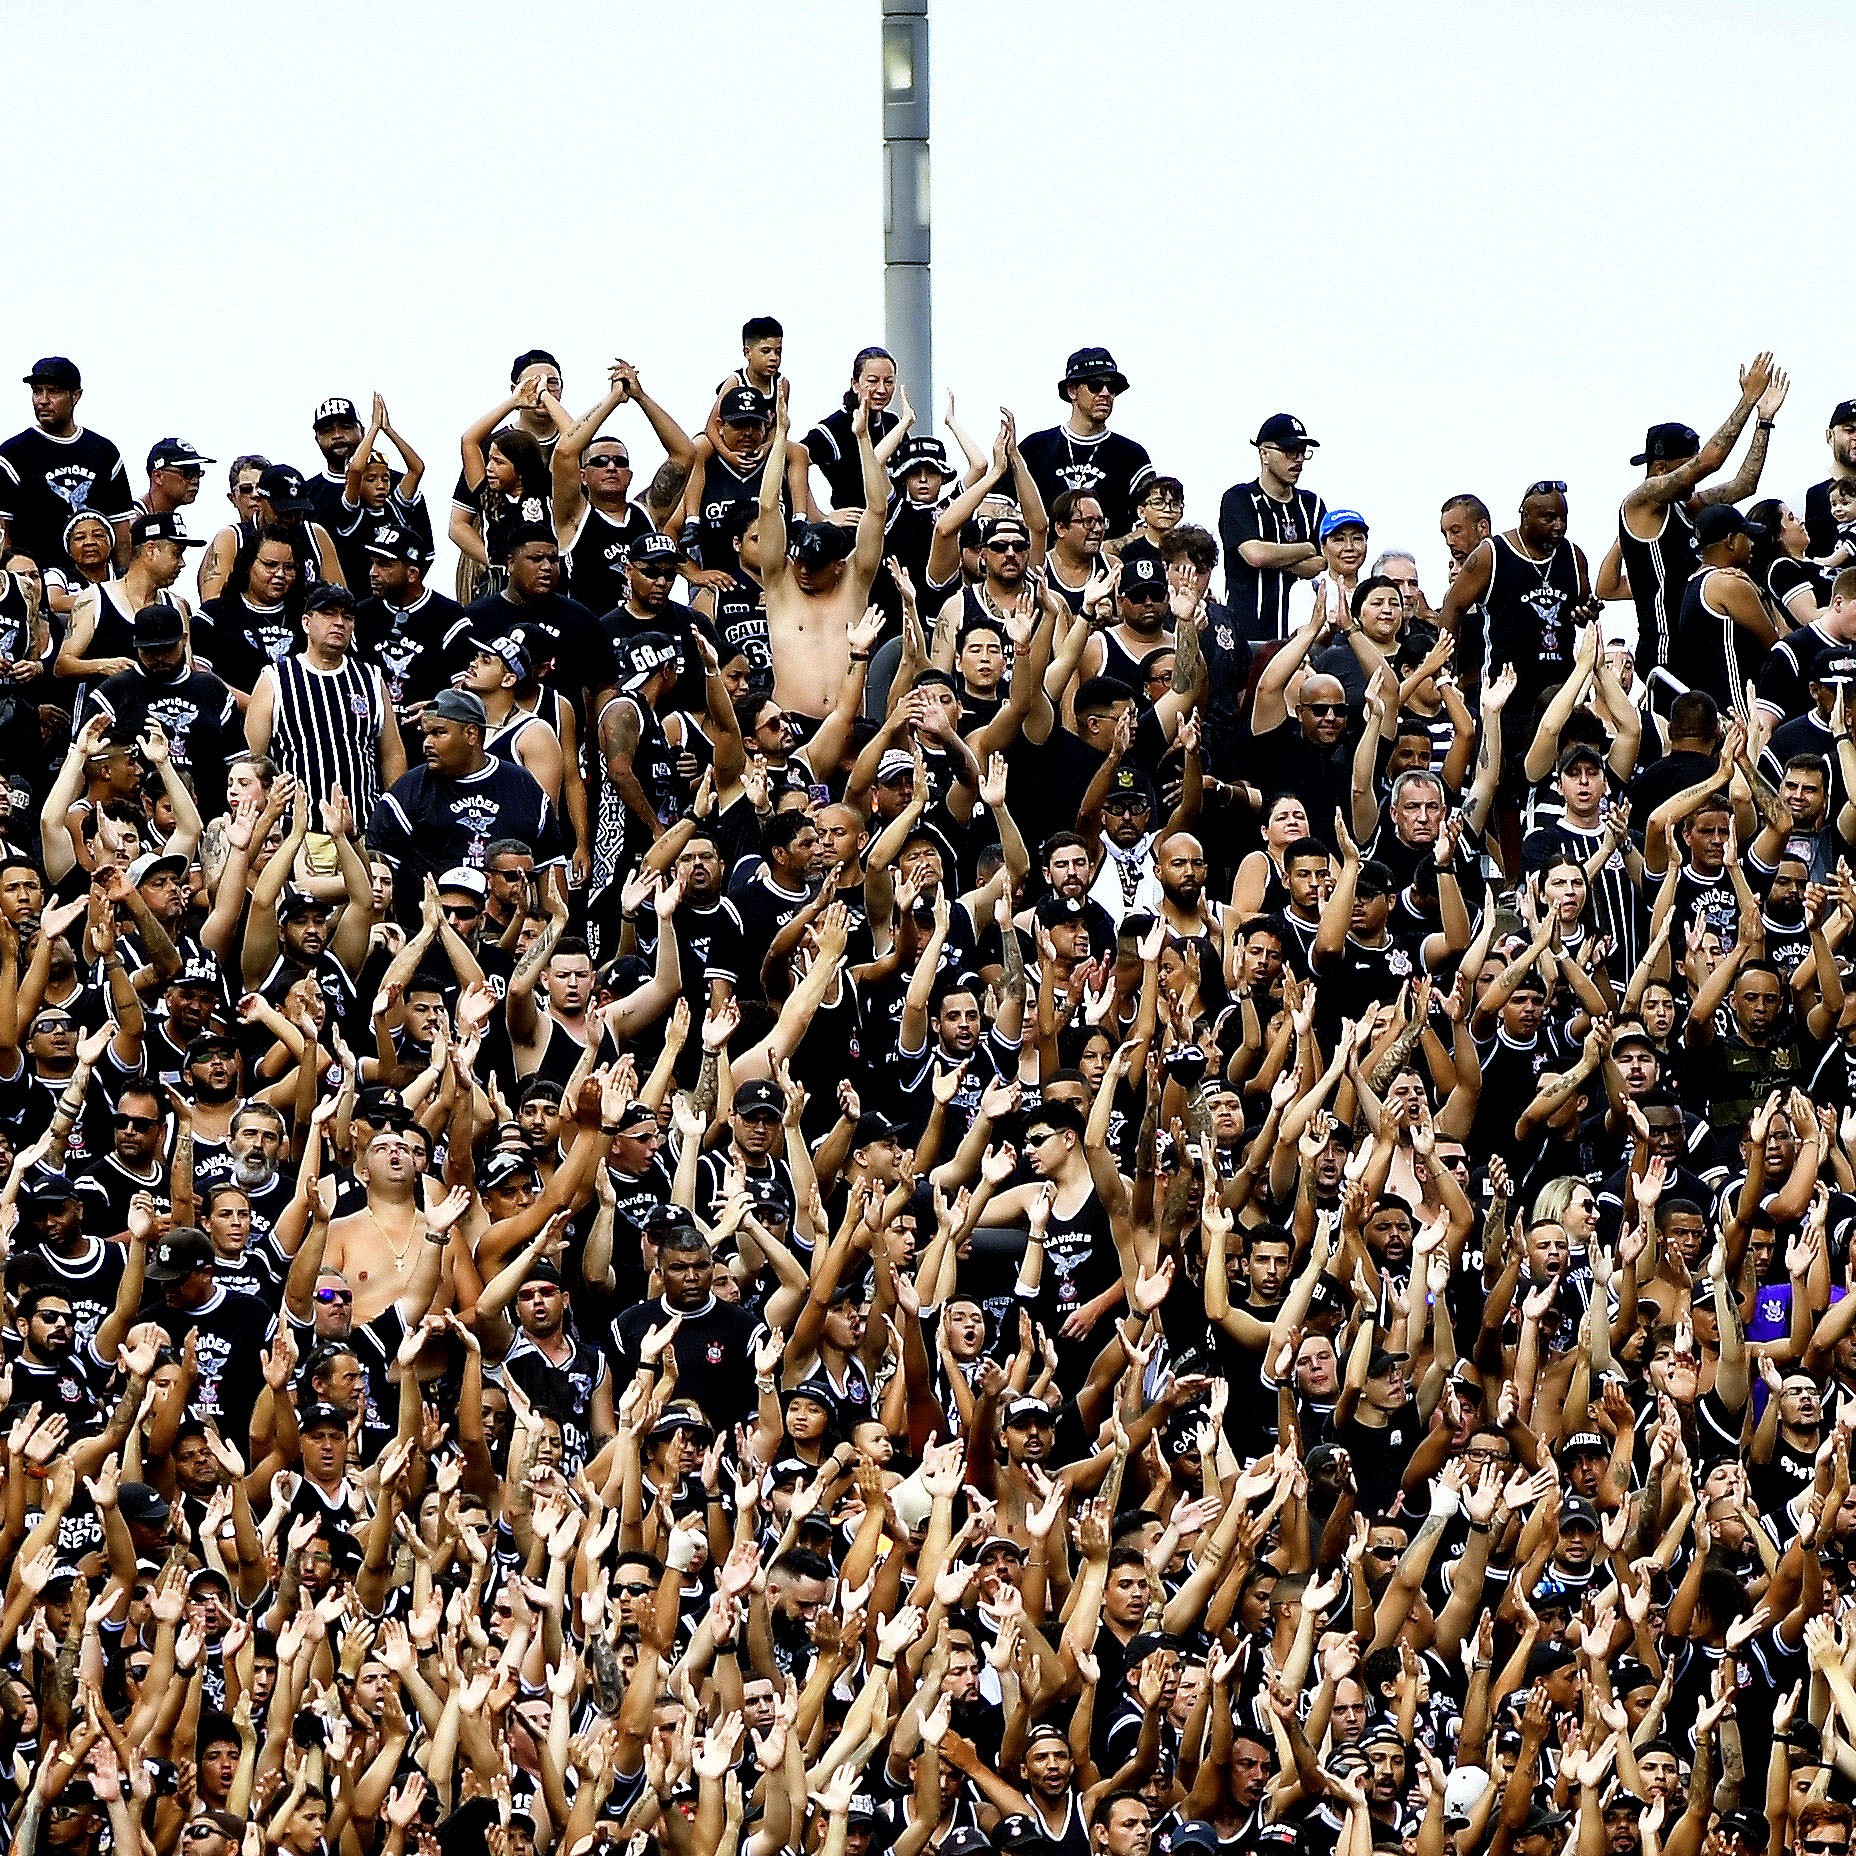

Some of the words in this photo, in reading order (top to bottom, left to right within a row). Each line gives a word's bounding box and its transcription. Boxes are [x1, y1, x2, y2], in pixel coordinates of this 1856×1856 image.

[317, 399, 350, 418] LHP
[147, 698, 198, 714] GAVIÕES
[449, 795, 500, 815] GAVIÕES
[1691, 888, 1735, 912] GAVIÕES
[1772, 942, 1812, 962] GAVIÕE
